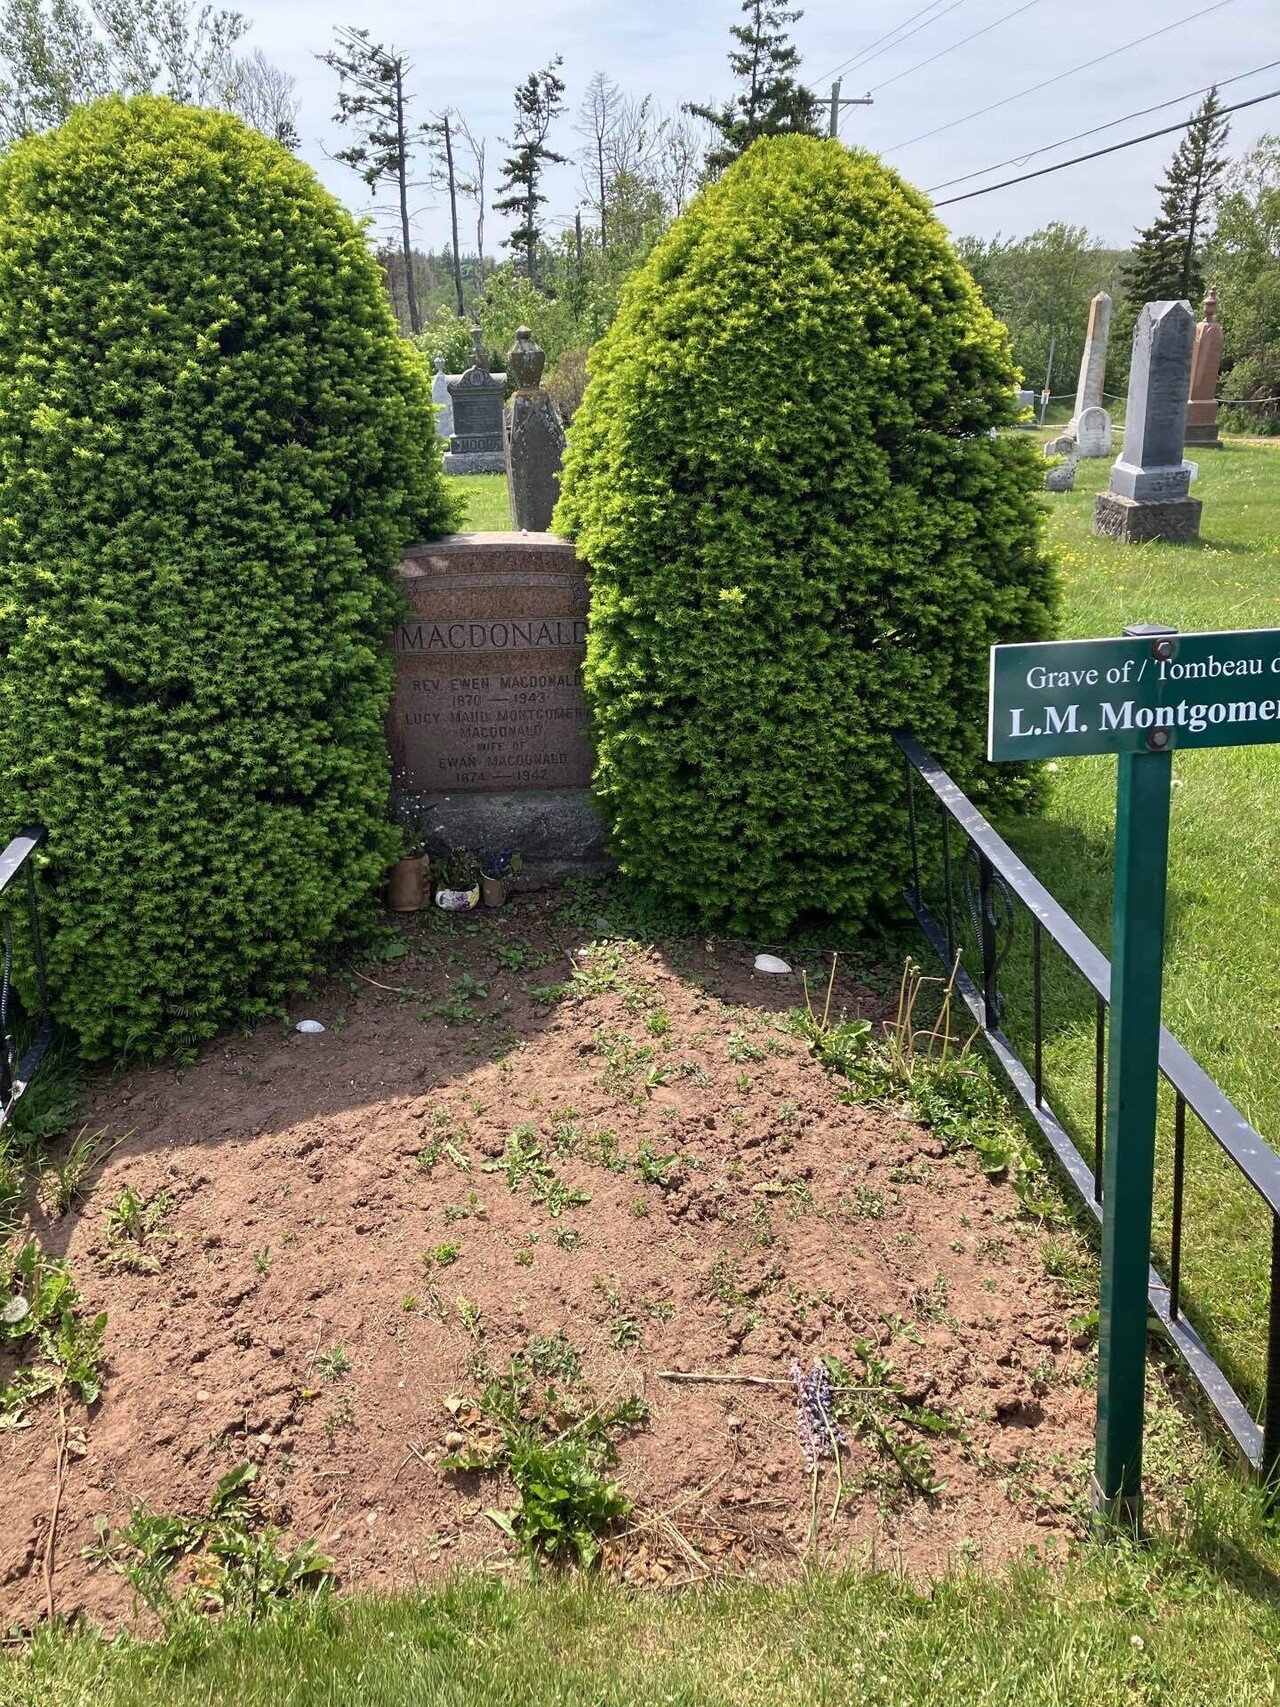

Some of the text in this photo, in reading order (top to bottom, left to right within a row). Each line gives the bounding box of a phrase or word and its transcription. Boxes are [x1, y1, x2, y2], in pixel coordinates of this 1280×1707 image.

[402, 621, 588, 650] MACDONALD
[1026, 666, 1099, 689] Grave
[1106, 660, 1135, 684] of
[1154, 655, 1264, 681] Tombeau
[451, 677, 490, 691] EWEN
[500, 675, 581, 689] MACDONALD
[452, 694, 482, 707] 1870
[513, 692, 546, 705] 1943
[405, 713, 440, 726] LUCY
[450, 711, 488, 723] MAUD
[1008, 699, 1280, 737] L.M. Montgome
[460, 725, 543, 739] MACDONALD
[477, 741, 526, 752] WIFE OF
[439, 753, 569, 769] EWAN MACDONALD
[517, 769, 548, 781] 1942
